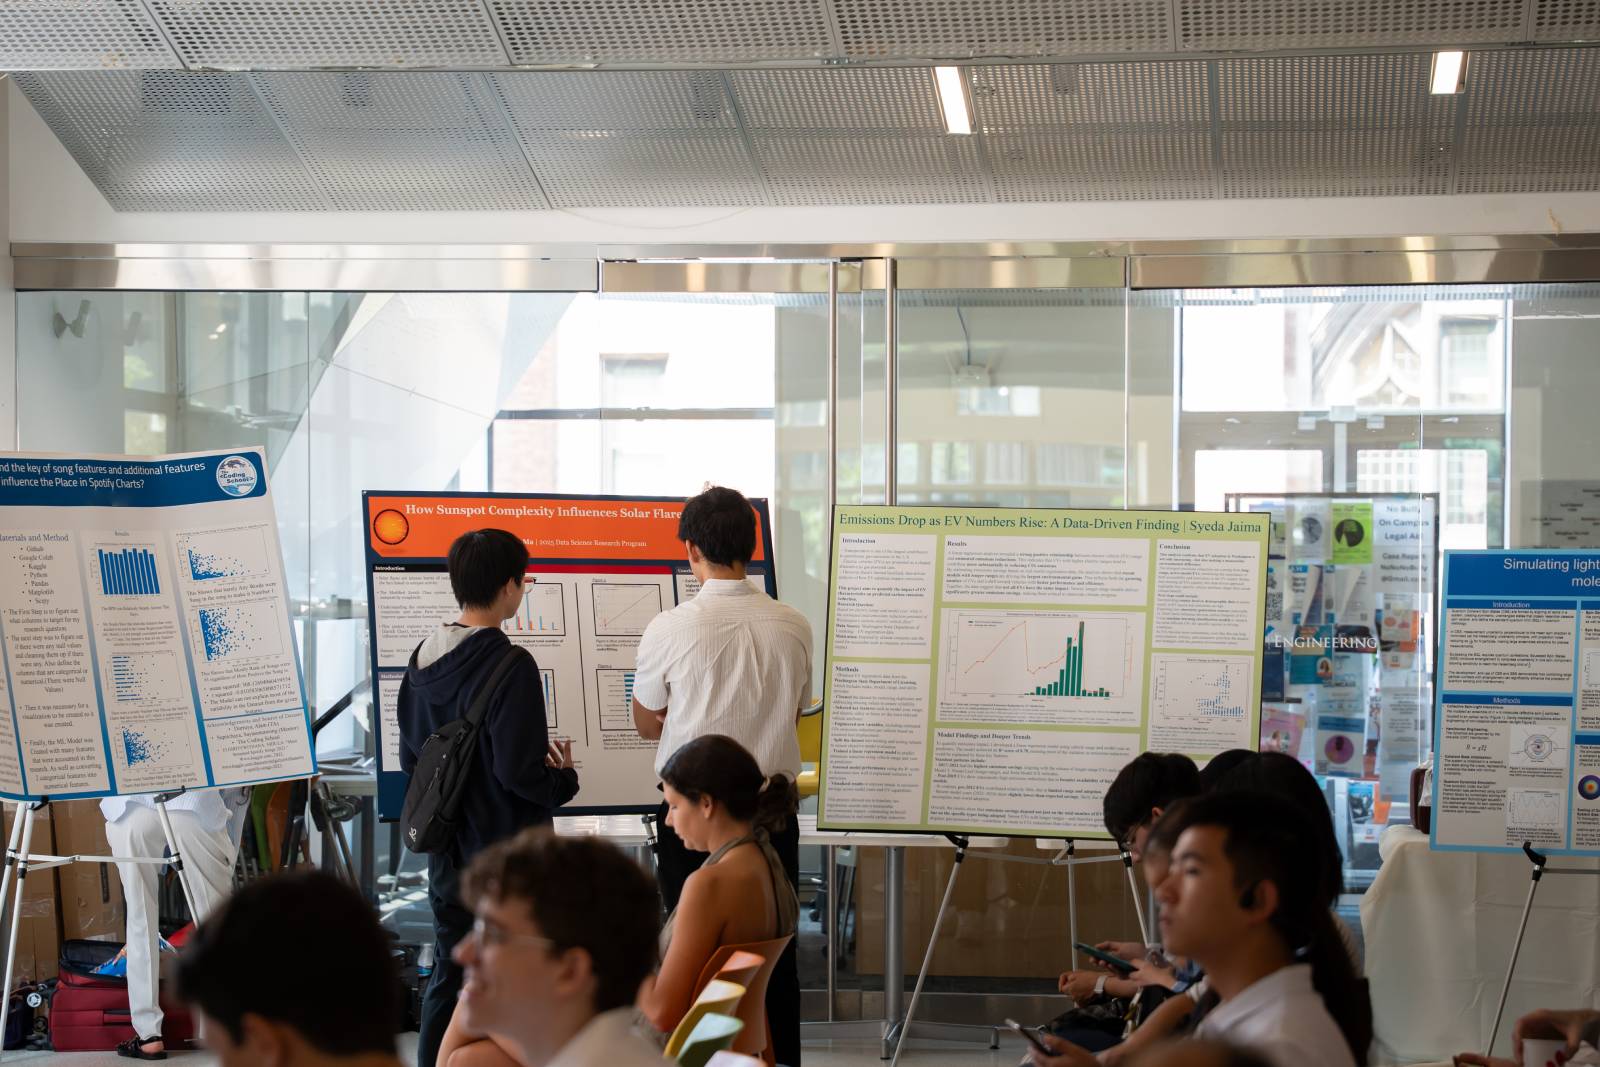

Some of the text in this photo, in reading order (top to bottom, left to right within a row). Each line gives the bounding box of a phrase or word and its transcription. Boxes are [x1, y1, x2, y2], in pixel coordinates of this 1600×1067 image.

[12, 463, 25, 473] the
[27, 463, 41, 475] key
[42, 464, 51, 473] of
[53, 465, 74, 476] song
[75, 464, 107, 475] features
[108, 465, 123, 475] and
[124, 465, 163, 475] additional
[165, 462, 206, 474] features
[1, 476, 144, 490] influence the Place in Spotify Charts?
[406, 504, 434, 514] How
[437, 504, 485, 517] Sunspot
[488, 505, 554, 518] Complexity
[558, 506, 618, 518] Influences
[620, 508, 650, 518] Solar
[840, 513, 896, 526] Emissions
[899, 514, 926, 528] Drop
[929, 517, 941, 526] as
[945, 515, 963, 526] EV
[966, 515, 1016, 527] Numbers
[1020, 516, 1047, 528] Rise:
[1050, 518, 1060, 528] A
[1063, 517, 1133, 531] Data-Driven
[1136, 519, 1180, 533] Finding
[1190, 520, 1224, 533] Syeda
[1228, 521, 1262, 533] Jaima
[1379, 519, 1391, 527] On
[28, 533, 41, 542] and
[43, 533, 69, 542] Method
[1385, 532, 1408, 541] Legal
[571, 540, 593, 548] Science
[594, 540, 621, 548] Research
[622, 541, 648, 550] Program
[947, 540, 968, 548] Results
[1402, 553, 1426, 561] Repot
[1503, 558, 1569, 573] Simulating
[1274, 635, 1378, 649] ENGINEERING
